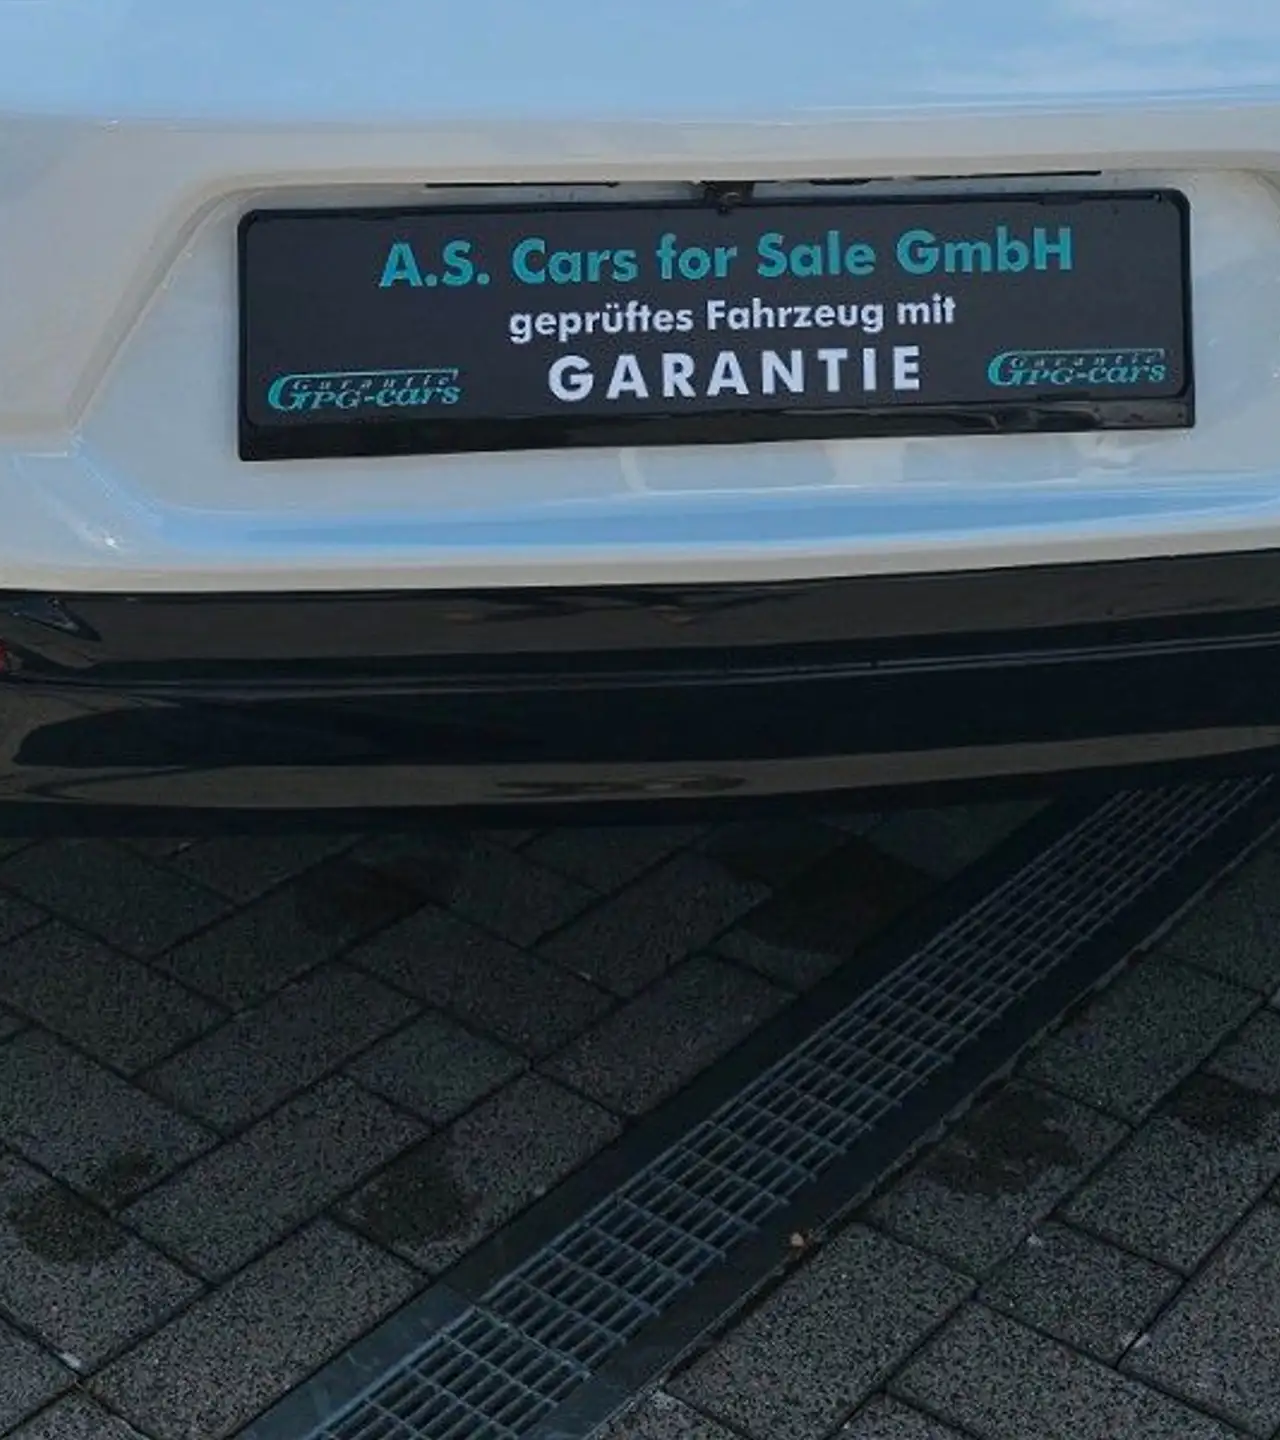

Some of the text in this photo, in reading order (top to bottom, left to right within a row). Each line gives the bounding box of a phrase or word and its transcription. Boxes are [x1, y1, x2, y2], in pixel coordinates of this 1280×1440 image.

[378, 224, 1073, 288] A.S. Cars for Sale GmbH
[508, 292, 958, 345] geprüftes Fahrzeug mit
[547, 344, 921, 403] GARANTIE
